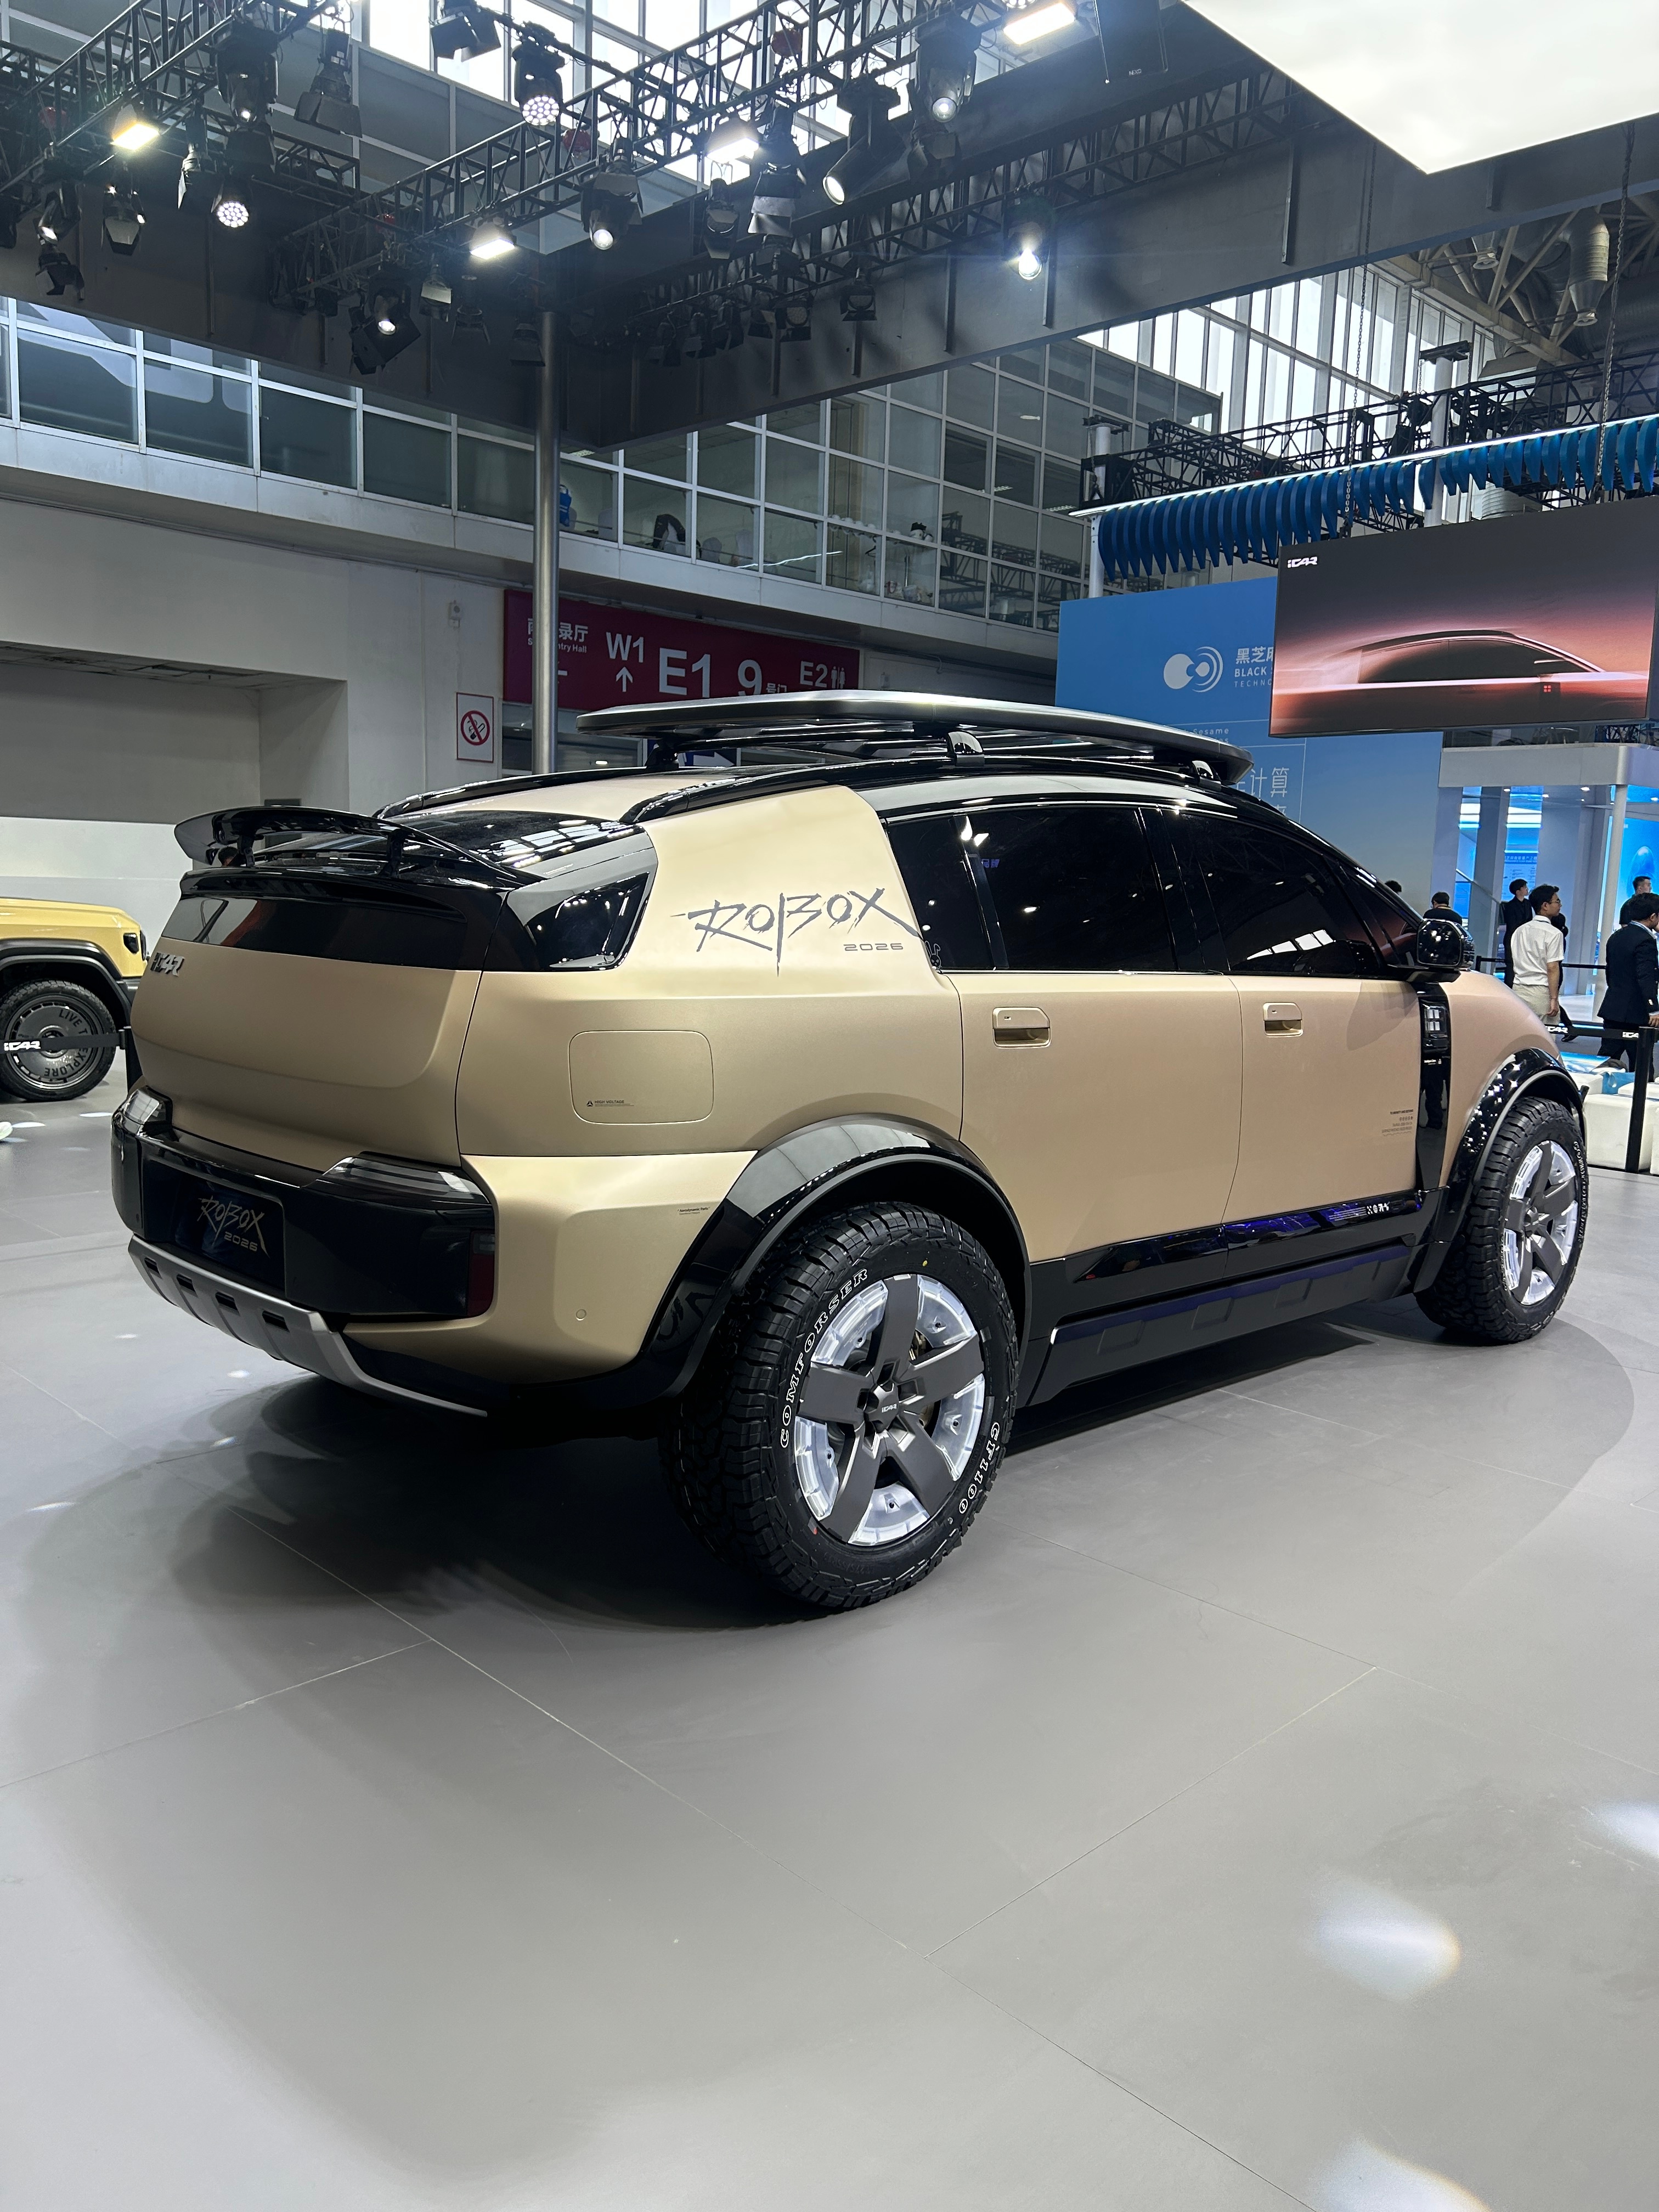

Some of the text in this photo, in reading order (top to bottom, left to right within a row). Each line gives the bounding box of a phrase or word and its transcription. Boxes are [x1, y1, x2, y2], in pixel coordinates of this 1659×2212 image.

[572, 644, 587, 653] Hall
[606, 631, 644, 663] W1
[659, 647, 711, 697] E1
[800, 661, 828, 688] E2
[1234, 666, 1267, 678] BLACK
[843, 943, 904, 952] 2026
[58, 1009, 83, 1028] LIVE
[43, 1047, 88, 1077] EXPLORE
[198, 1195, 271, 1259] ROBOX
[224, 1231, 258, 1252] 2026
[780, 1269, 868, 1448] COMFORSER
